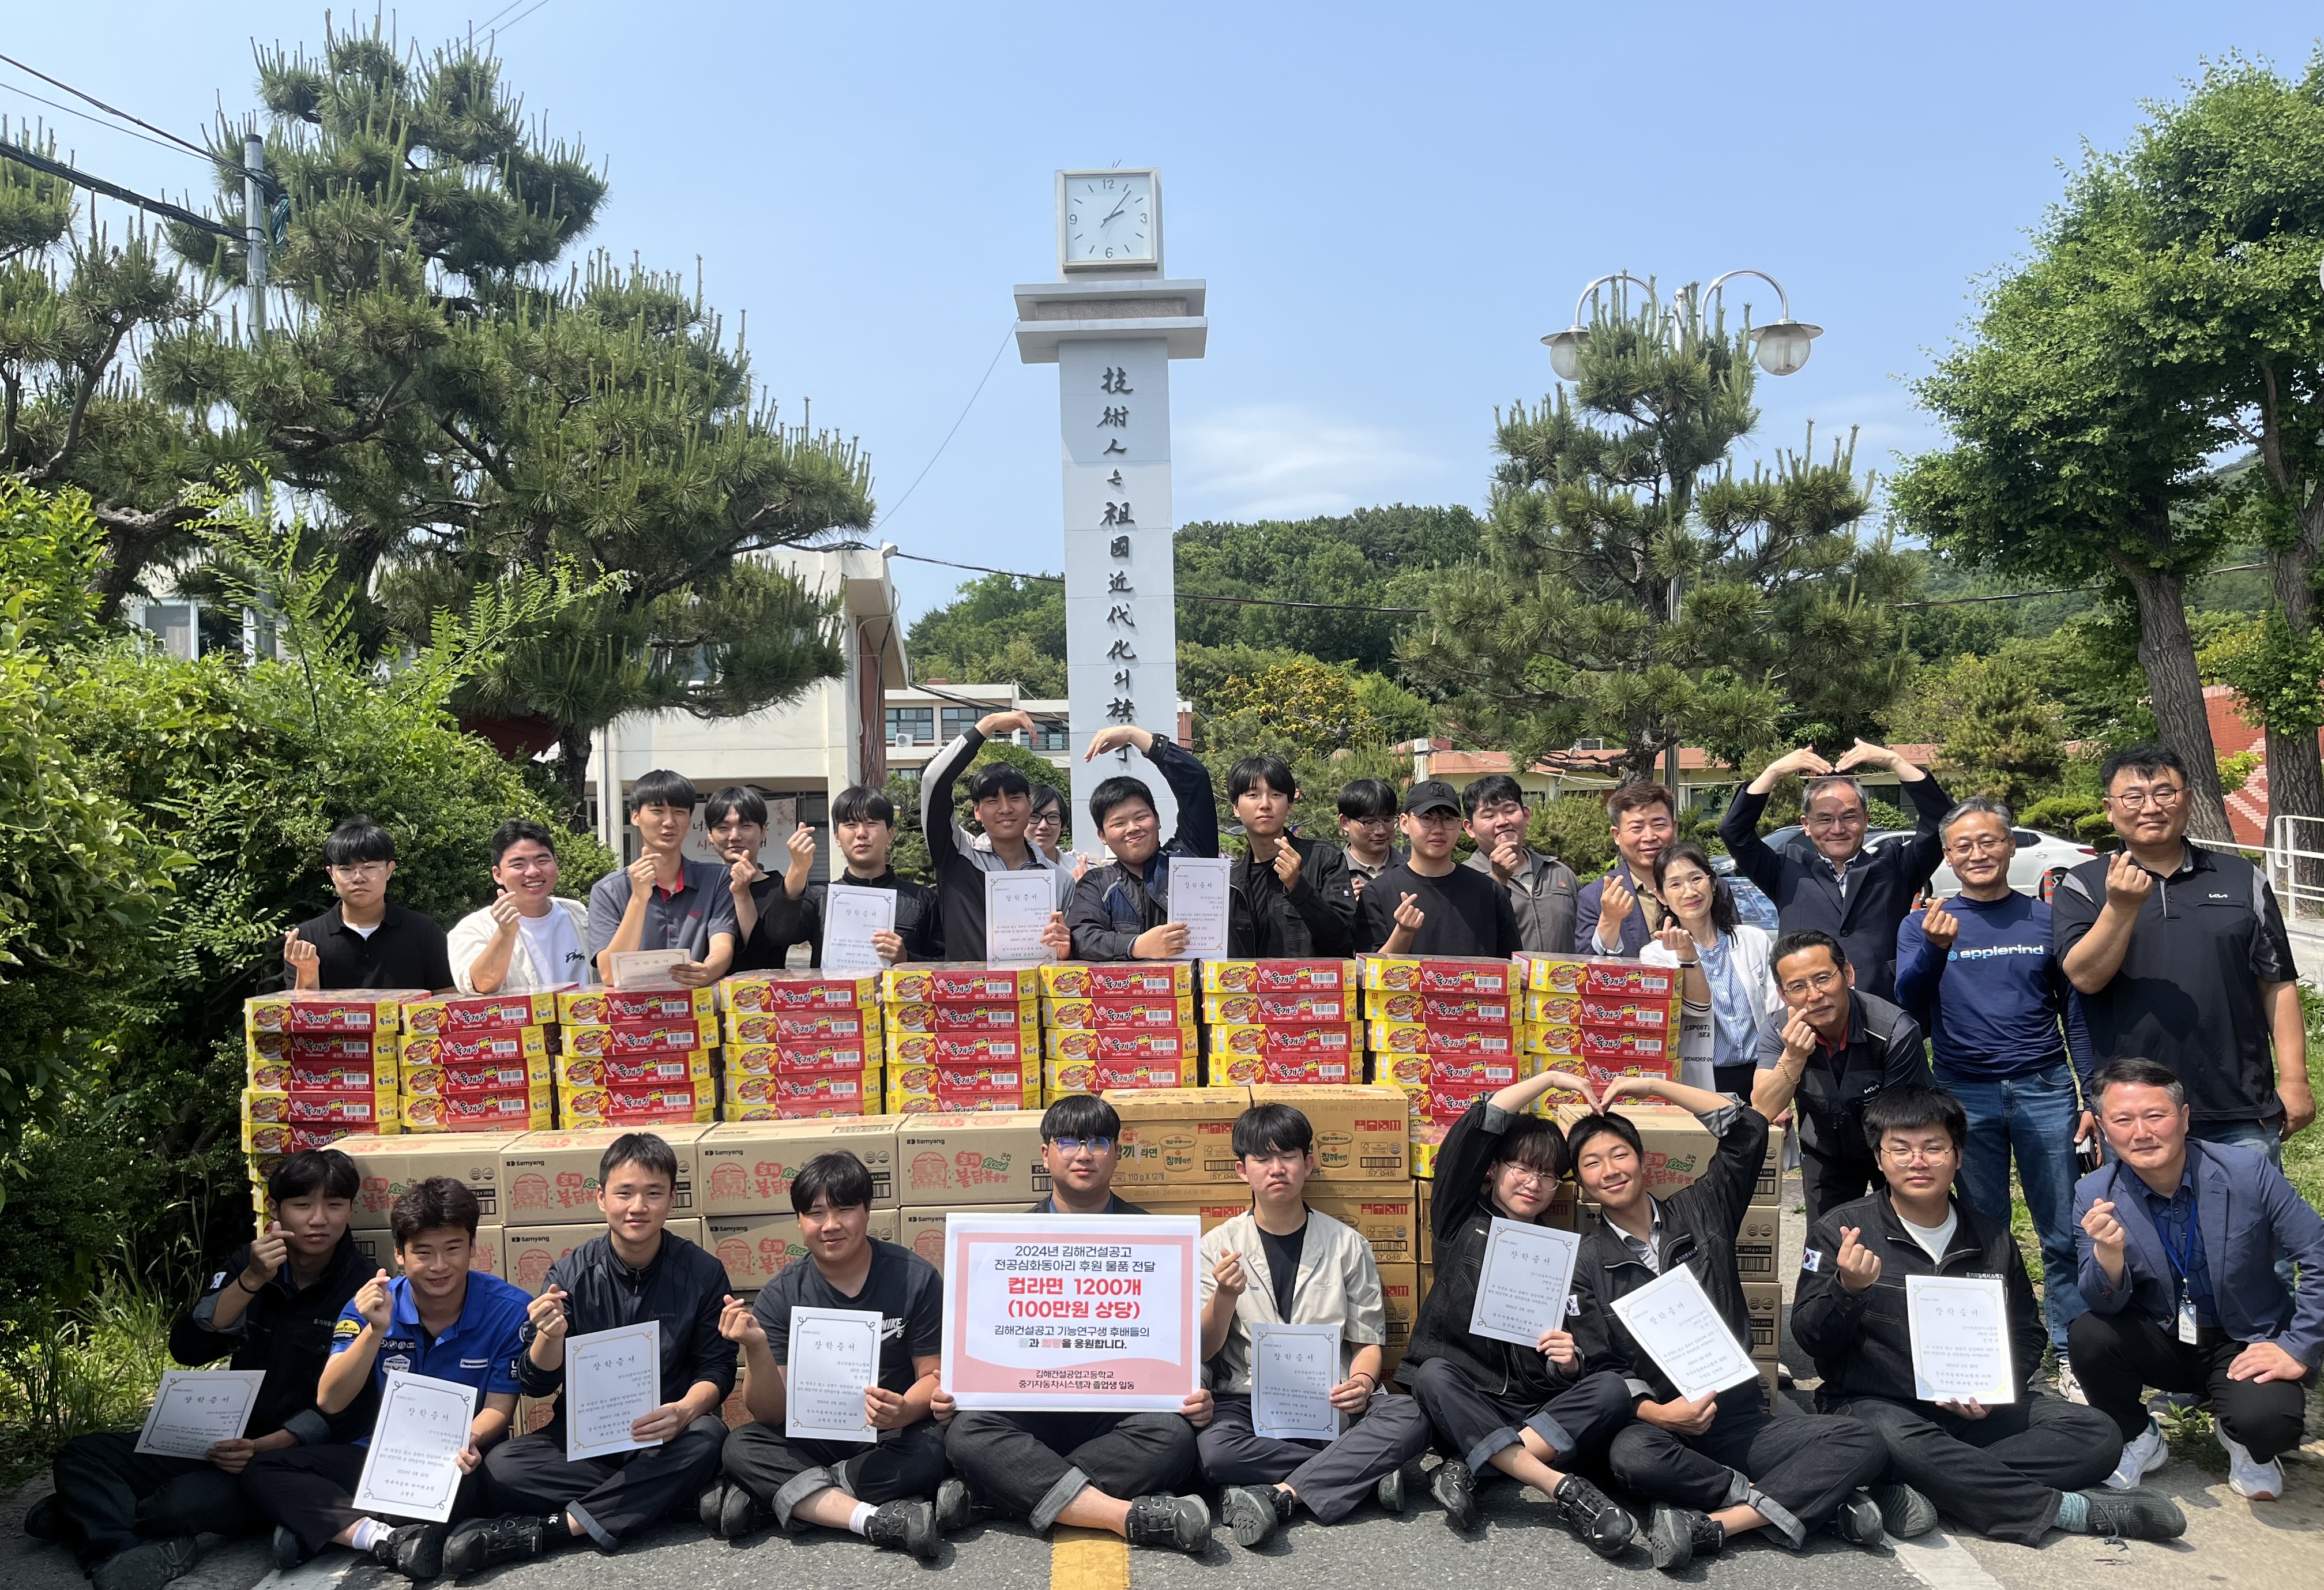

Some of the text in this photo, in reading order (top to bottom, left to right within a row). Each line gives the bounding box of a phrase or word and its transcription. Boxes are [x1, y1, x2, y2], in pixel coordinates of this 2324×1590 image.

[1103, 179, 1115, 190] 12
[1069, 214, 1078, 225] 9
[1140, 213, 1148, 223] 3
[1105, 247, 1113, 258] 6
[1960, 944, 2044, 960] applerind
[1271, 972, 1296, 984] 육개장
[1434, 974, 1460, 986] 육개장
[1462, 973, 1474, 981] BIG
[1600, 973, 1626, 986] 육개장
[1629, 973, 1640, 981] BIG
[946, 982, 971, 994] 육개장
[1104, 978, 1129, 989] 육개장
[785, 992, 810, 1003] 육개장
[488, 1006, 499, 1014] BIG
[622, 1003, 648, 1014] 육개장
[1272, 1003, 1298, 1016] 육개장
[1437, 1003, 1464, 1015] 육개장
[1595, 1008, 1622, 1019] 육개장
[1623, 1006, 1635, 1014] BIG
[304, 1012, 330, 1024] 육개장
[462, 1012, 487, 1023] 육개장
[949, 1011, 974, 1023] 육개장
[1106, 1010, 1132, 1021] 육개장
[791, 1023, 817, 1034] 육개장
[818, 1019, 830, 1027] BIG
[626, 1035, 652, 1046] 육개장
[653, 1031, 665, 1039] BIG
[1138, 1036, 1149, 1044] BIG
[1280, 1035, 1306, 1046] 육개장
[1307, 1032, 1319, 1040] BIG
[1623, 1035, 1634, 1043] BIG
[304, 1040, 330, 1051] 육개장
[976, 1040, 988, 1048] BIG
[1111, 1040, 1137, 1050] 육개장
[1441, 1035, 1466, 1047] 육개장
[1595, 1037, 1621, 1048] 육개장
[453, 1044, 478, 1055] 육개장
[820, 1049, 832, 1057] BIG
[949, 1043, 975, 1055] 육개장
[960, 1154, 980, 1164] 로제
[759, 1164, 779, 1175] 로제
[1152, 1172, 1164, 1181] 12개
[764, 1241, 783, 1251] 로제
[1015, 1246, 1131, 1258] 2024년 김해건설공고
[994, 1260, 1156, 1273] 전공심화동아리 후원 물품 전달
[1008, 1277, 1141, 1296] 컵라면 1200개
[1008, 1299, 1141, 1320] (100만원 상당)
[995, 1325, 1149, 1337] 김해건설공고 기능연구생 후배들의
[1074, 1339, 1127, 1349] 응원합니다.
[1036, 1370, 1114, 1379] 김해건설공업고등학교
[1019, 1380, 1135, 1389] 중기자동차시스템과 졸업생 일동
